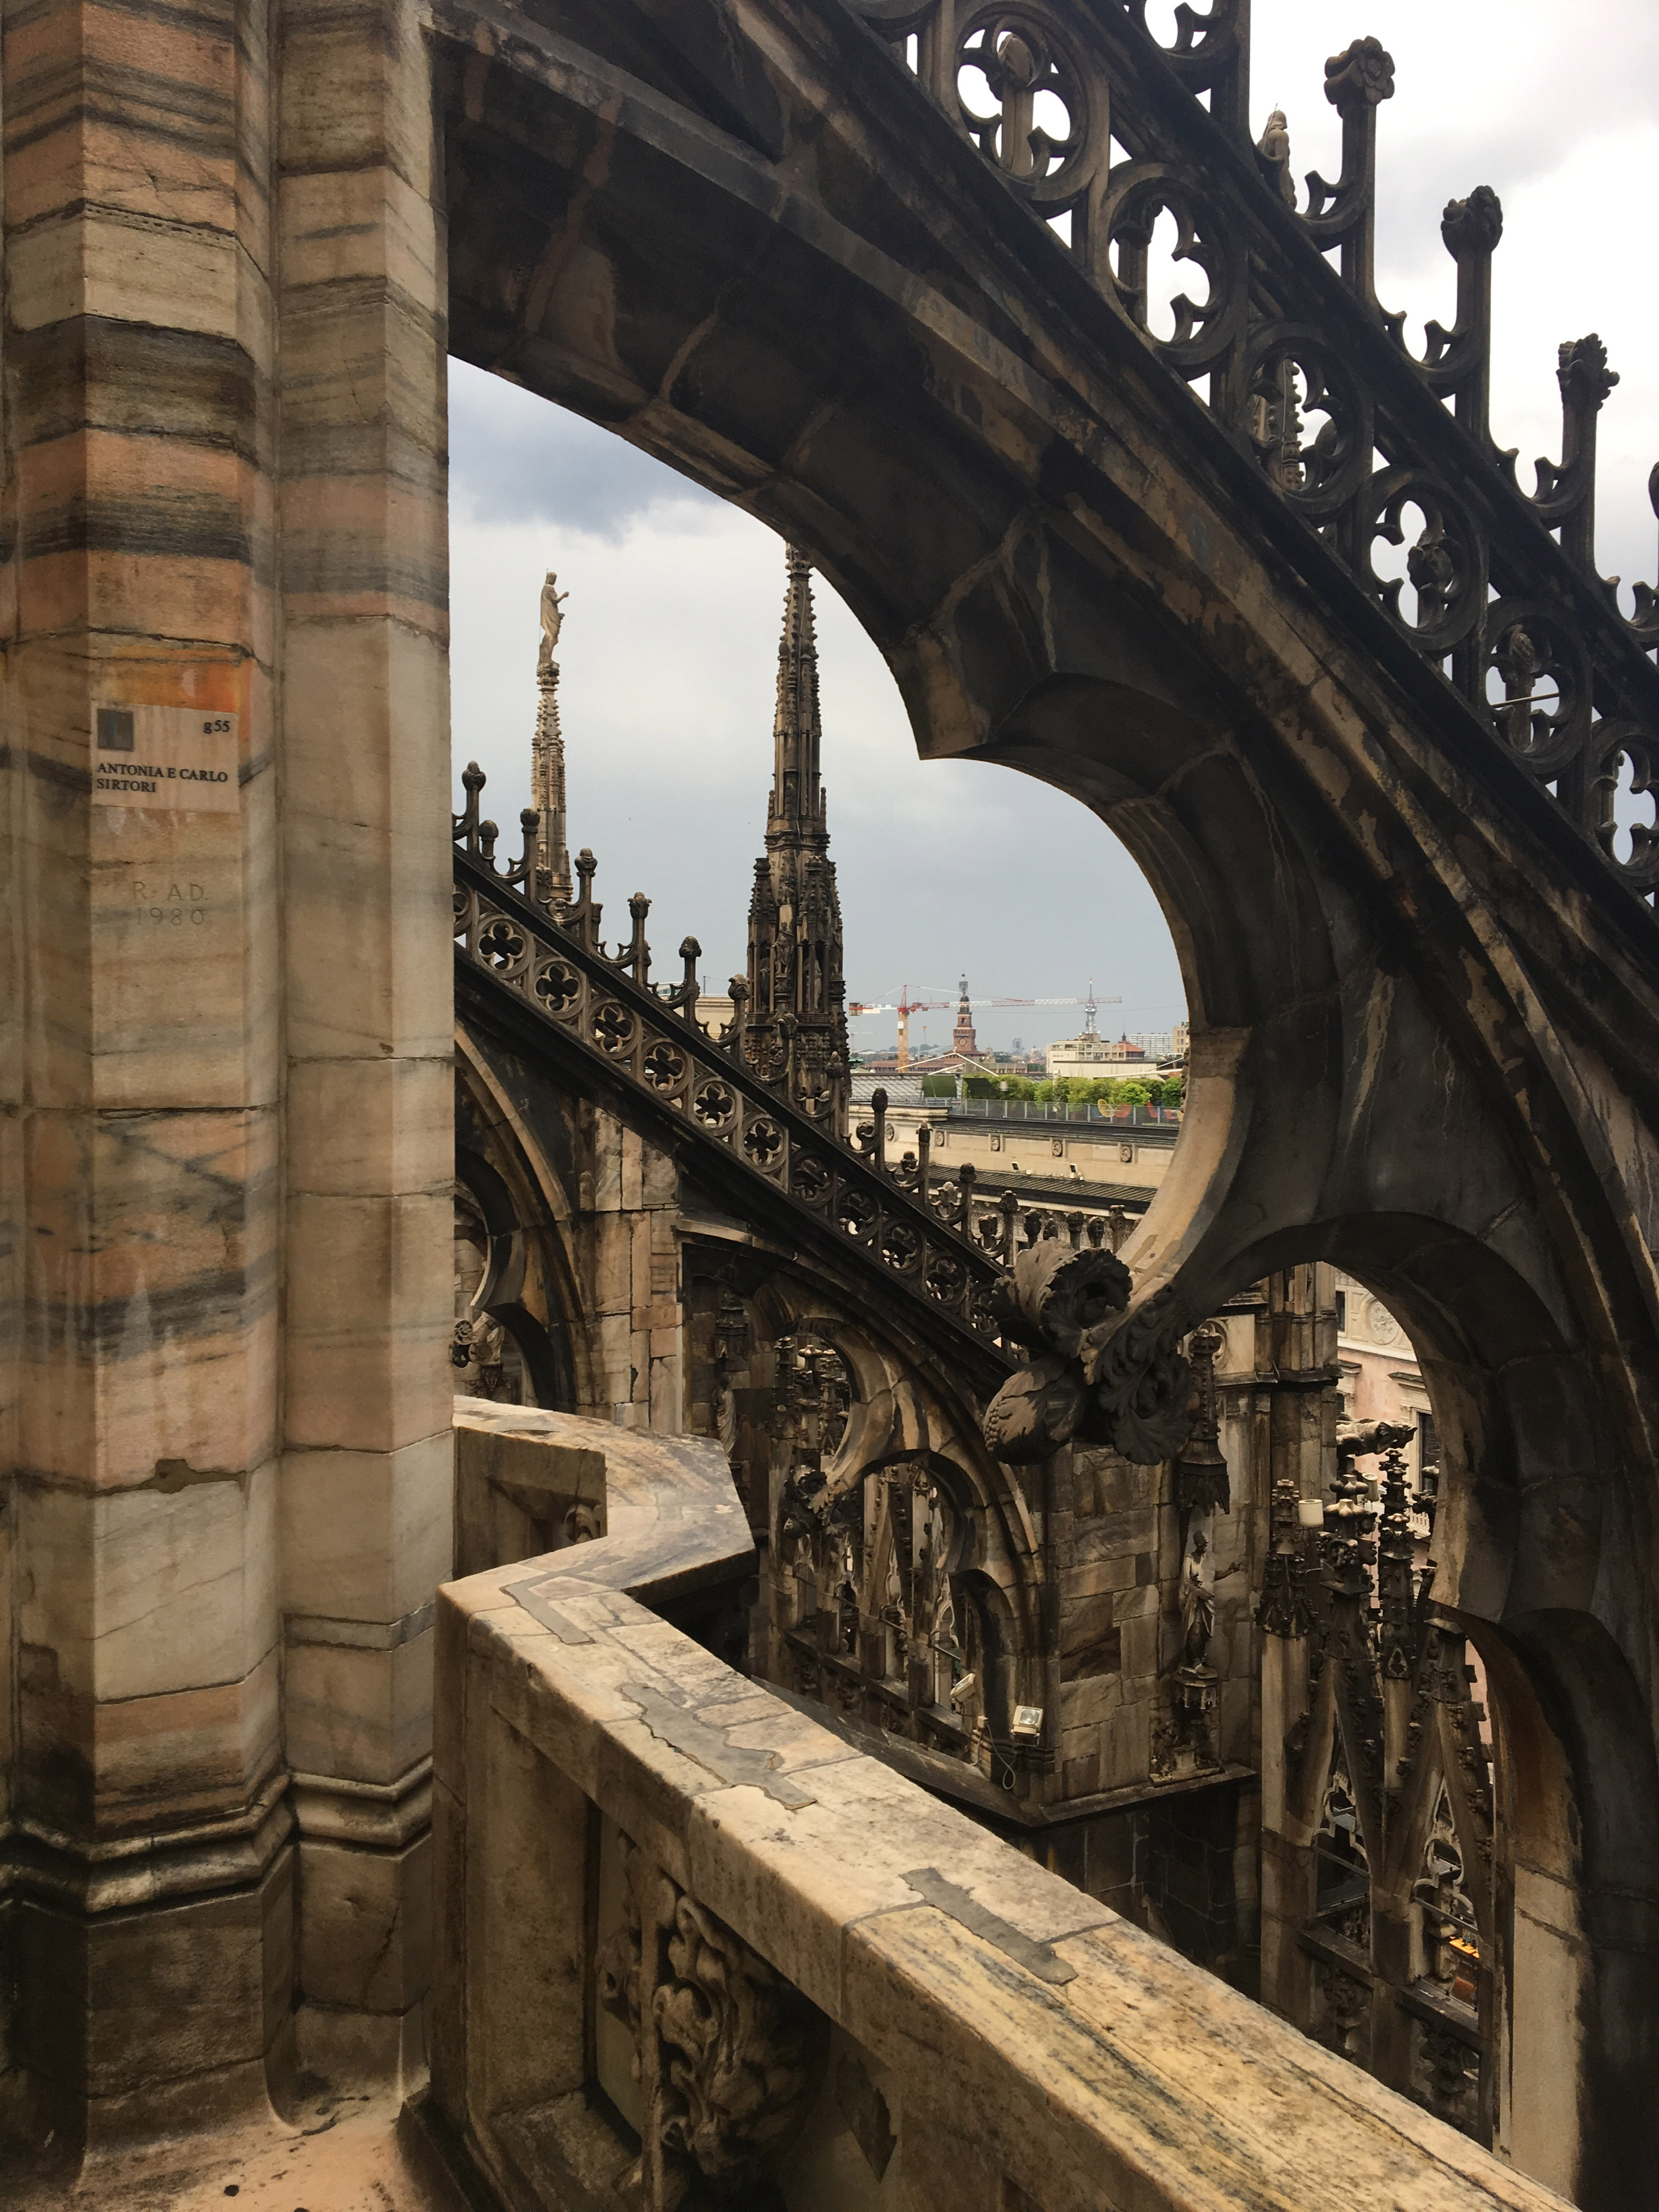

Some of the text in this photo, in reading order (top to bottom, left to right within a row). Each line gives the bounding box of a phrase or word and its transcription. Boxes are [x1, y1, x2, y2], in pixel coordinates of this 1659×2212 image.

[97, 762, 228, 783] ANTONIA E CARLO
[97, 778, 157, 792] SIRTORI
[137, 907, 205, 926] 1980
